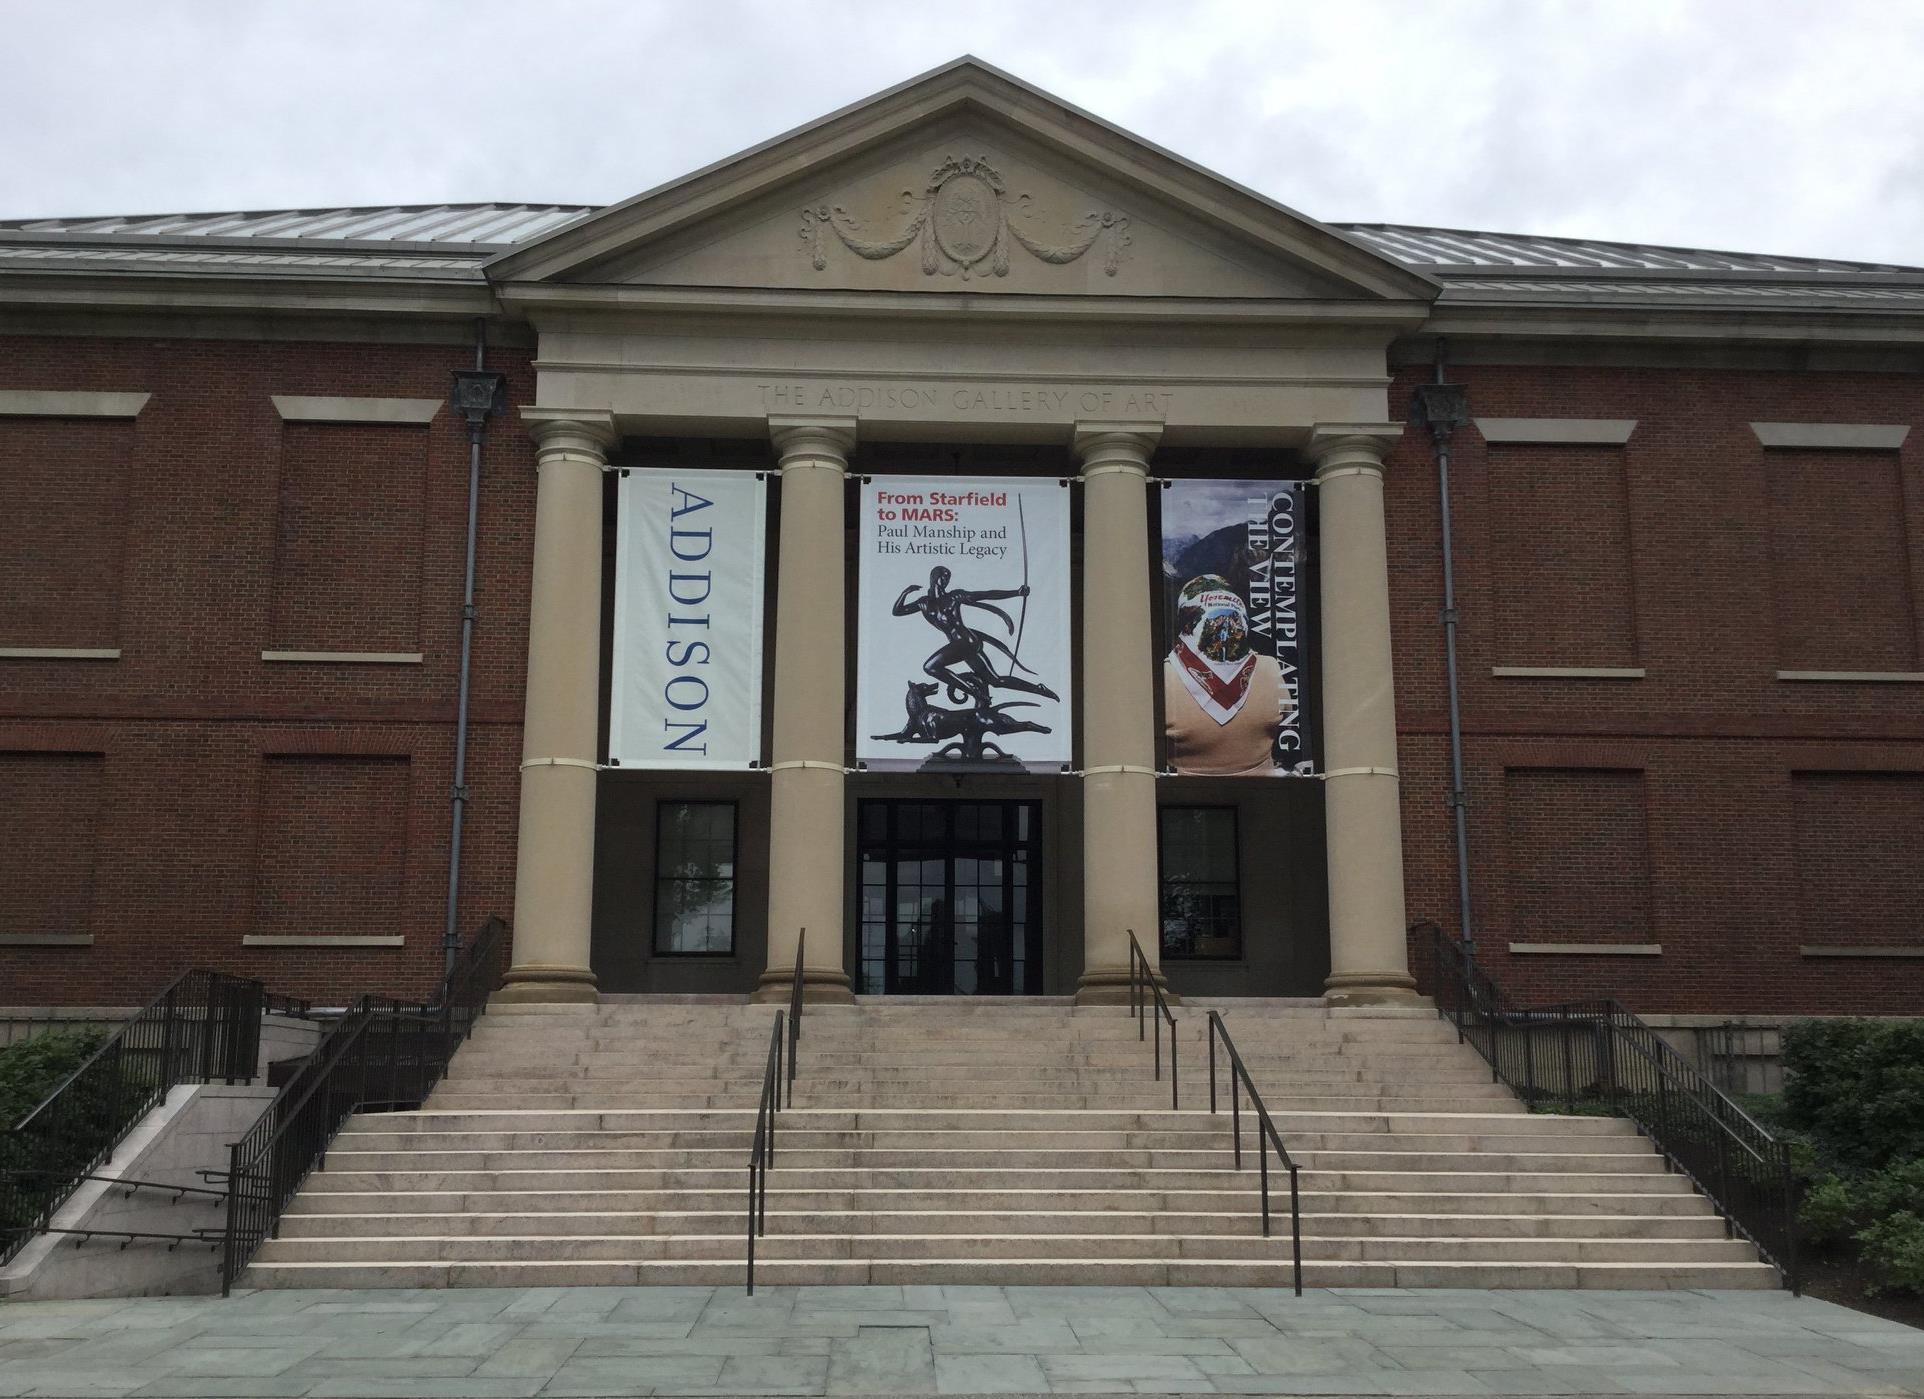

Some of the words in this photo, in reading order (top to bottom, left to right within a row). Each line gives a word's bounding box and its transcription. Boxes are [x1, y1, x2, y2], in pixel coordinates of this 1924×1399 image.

[758, 385, 805, 408] THE
[818, 386, 938, 411] ADDISON
[952, 389, 1070, 413] GALLERY
[1079, 391, 1113, 413] OF
[1124, 392, 1175, 414] ART
[877, 491, 924, 505] From
[929, 492, 1007, 507] Starfield
[877, 508, 897, 521] to
[901, 508, 959, 522] MARS:
[1247, 493, 1269, 551] THE
[878, 524, 908, 538] Paul
[913, 525, 976, 542] Manship
[980, 526, 1007, 539] and
[877, 541, 901, 554] His
[905, 542, 955, 555] Artistic
[960, 542, 1008, 560] Legacy
[1249, 556, 1273, 638] VIEW
[663, 482, 714, 756] ADDISON
[1271, 492, 1301, 752] CONTEMPLATING
